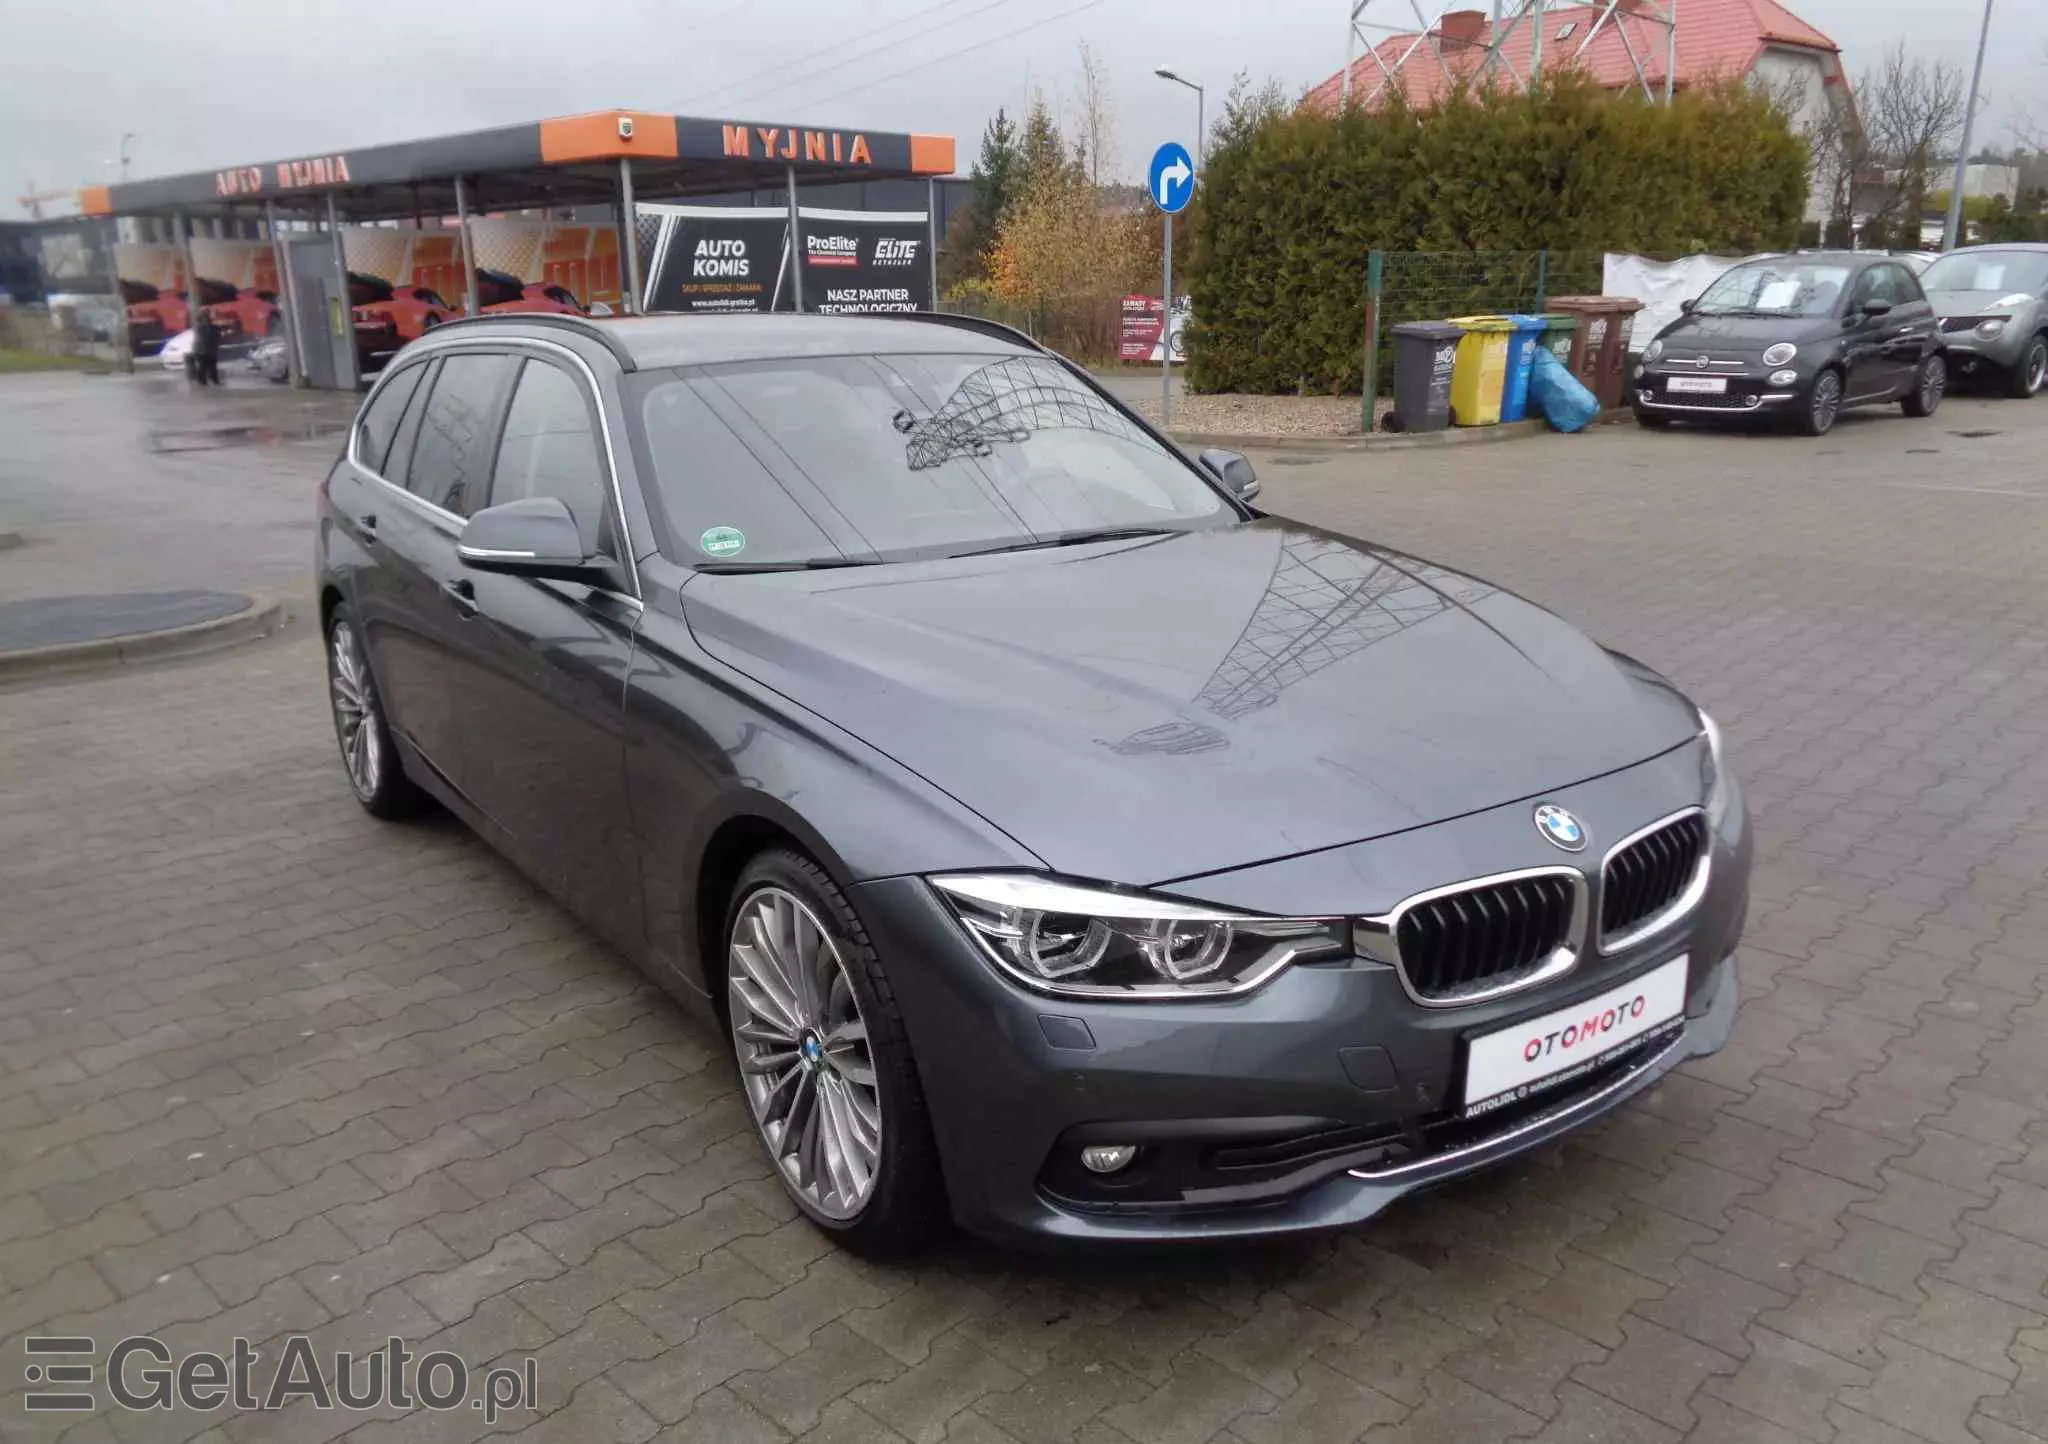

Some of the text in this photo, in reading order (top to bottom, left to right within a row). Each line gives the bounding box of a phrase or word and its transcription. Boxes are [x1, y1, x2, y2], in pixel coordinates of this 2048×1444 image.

[722, 124, 872, 164] MYJNIA
[216, 155, 350, 196] AUTO MYJNIA
[694, 239, 746, 257] AUTO
[807, 235, 857, 250] ProElite
[693, 259, 750, 276] KOMIS
[827, 288, 909, 301] NASZ PARTNER
[818, 302, 918, 314] TECHNOLOGICZNY
[1523, 995, 1645, 1062] OTOMOTO
